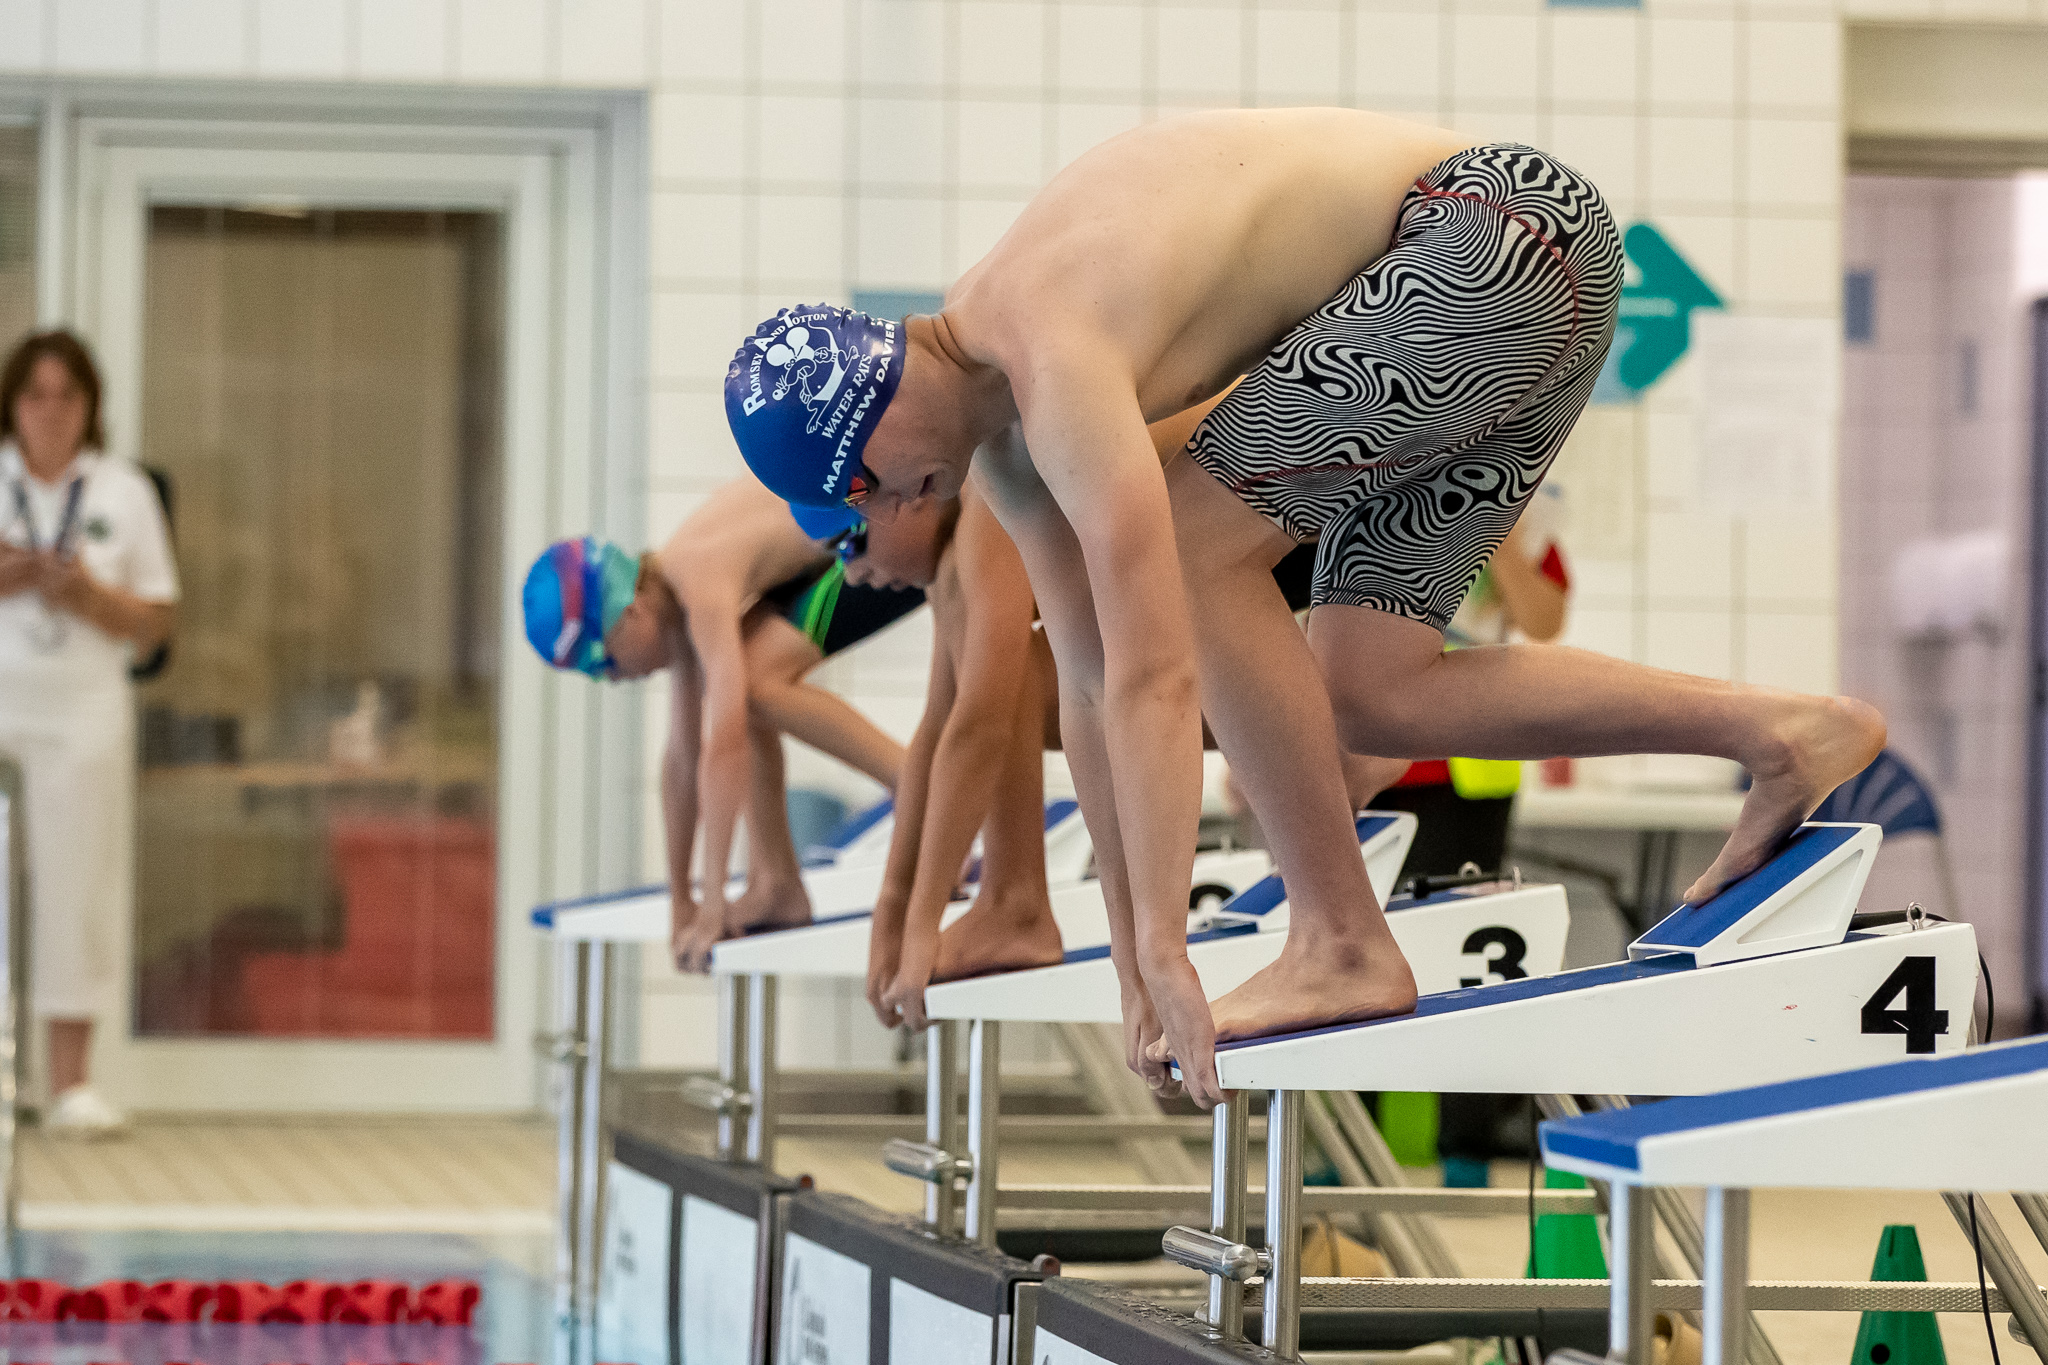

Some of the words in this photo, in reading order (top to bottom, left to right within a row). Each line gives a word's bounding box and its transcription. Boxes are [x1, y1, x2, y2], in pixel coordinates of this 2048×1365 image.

[821, 388, 858, 440] WATER
[852, 353, 873, 389] RATS
[822, 386, 876, 495] MATTHEW
[875, 323, 896, 384] DAVIES
[1460, 926, 1529, 988] 3
[1861, 956, 1949, 1054] 4
